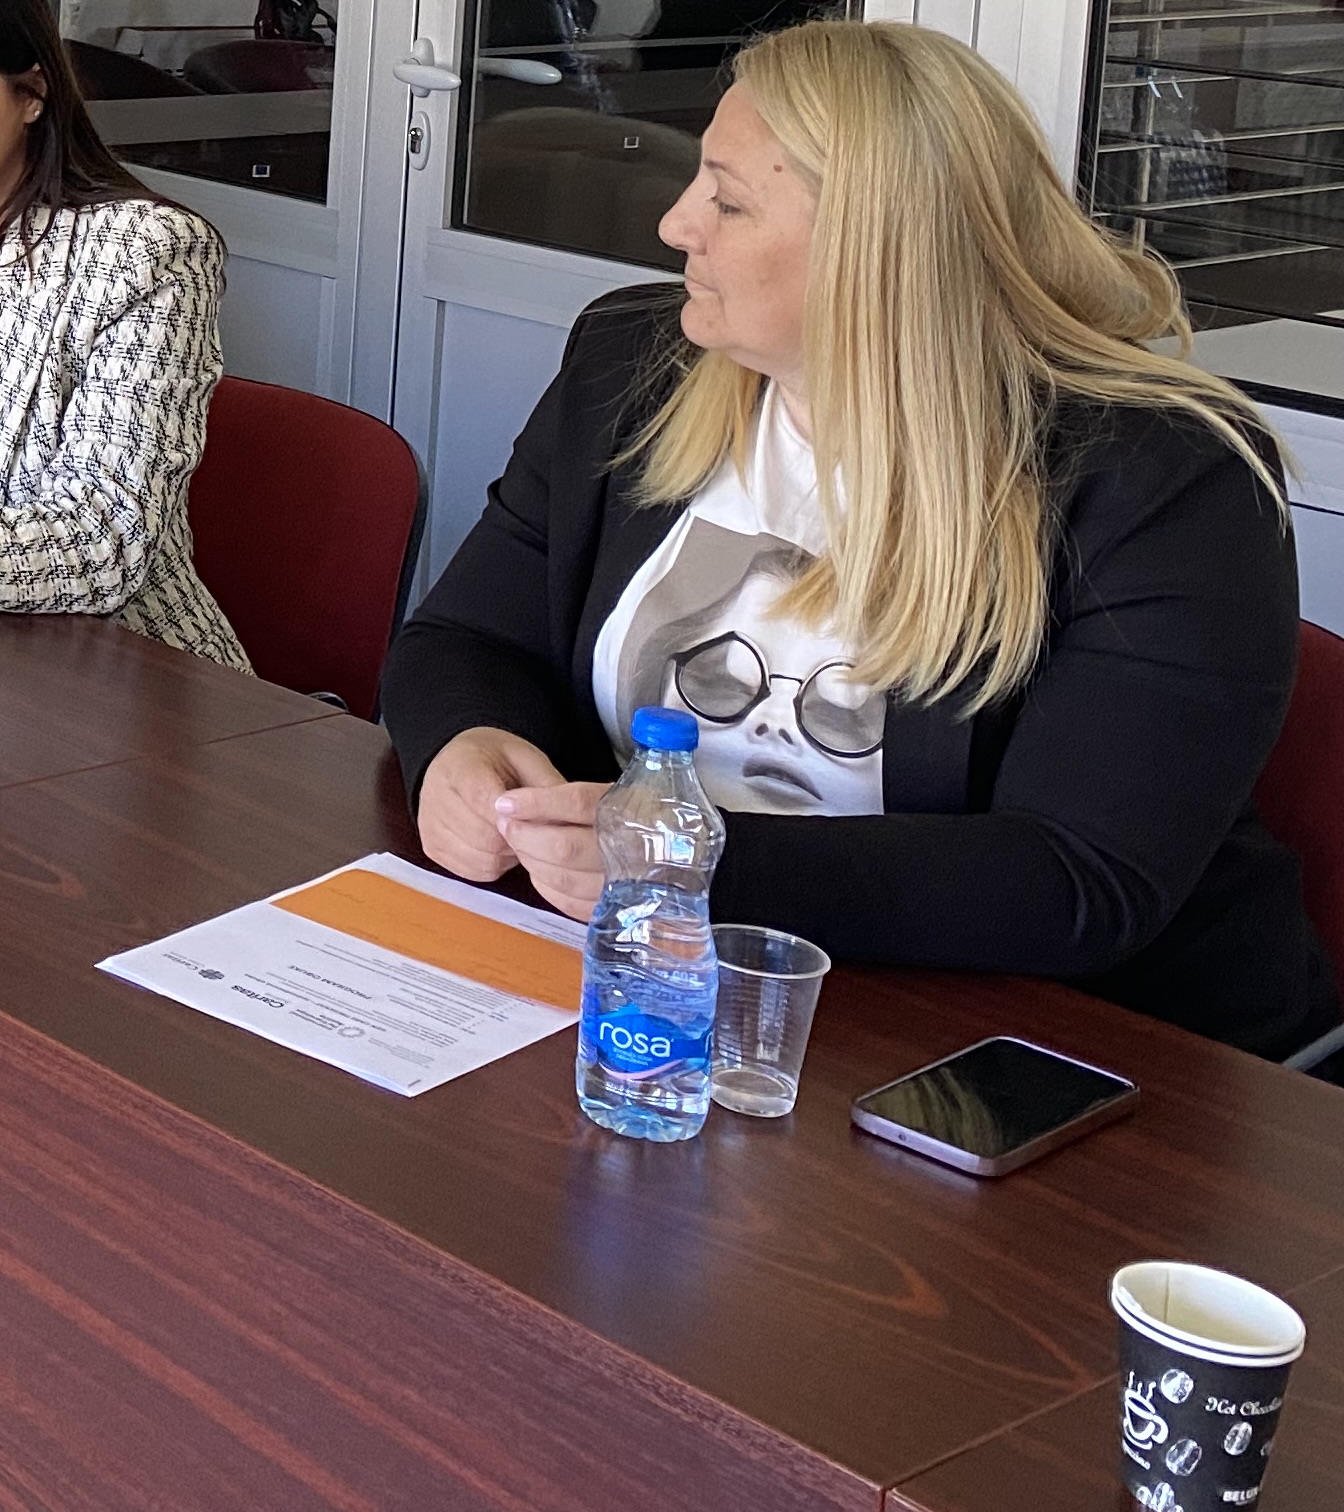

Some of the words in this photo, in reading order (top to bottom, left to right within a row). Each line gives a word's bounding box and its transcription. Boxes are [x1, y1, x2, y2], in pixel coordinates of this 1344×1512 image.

[231, 984, 285, 1008] Caritas
[599, 1022, 671, 1058] rosa
[1205, 1396, 1236, 1416] Hot
